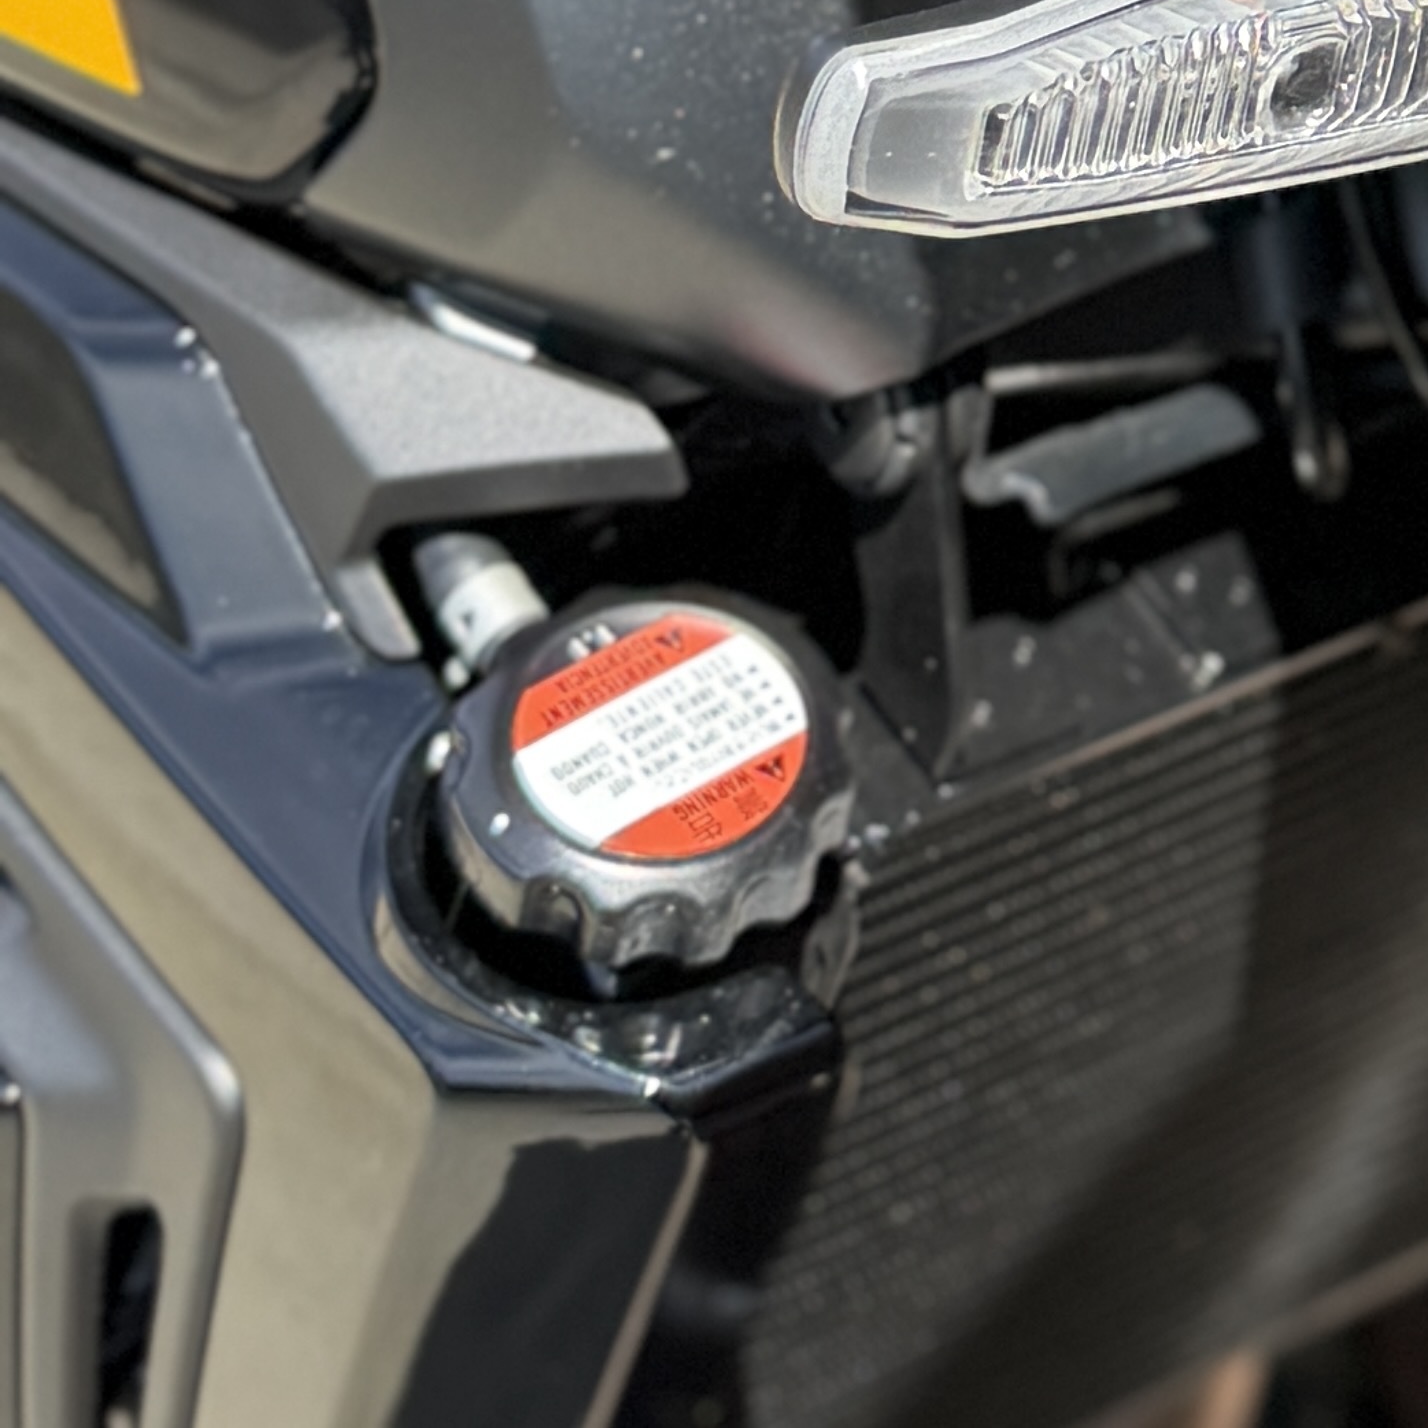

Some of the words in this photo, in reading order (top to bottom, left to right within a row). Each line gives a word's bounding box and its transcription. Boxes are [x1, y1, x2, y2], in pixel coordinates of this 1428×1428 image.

[540, 652, 667, 729] AVERTISSEMENT
[555, 637, 651, 692] ADVERTENCIA
[549, 740, 611, 781] CUANDO
[672, 769, 753, 821] WARNING
